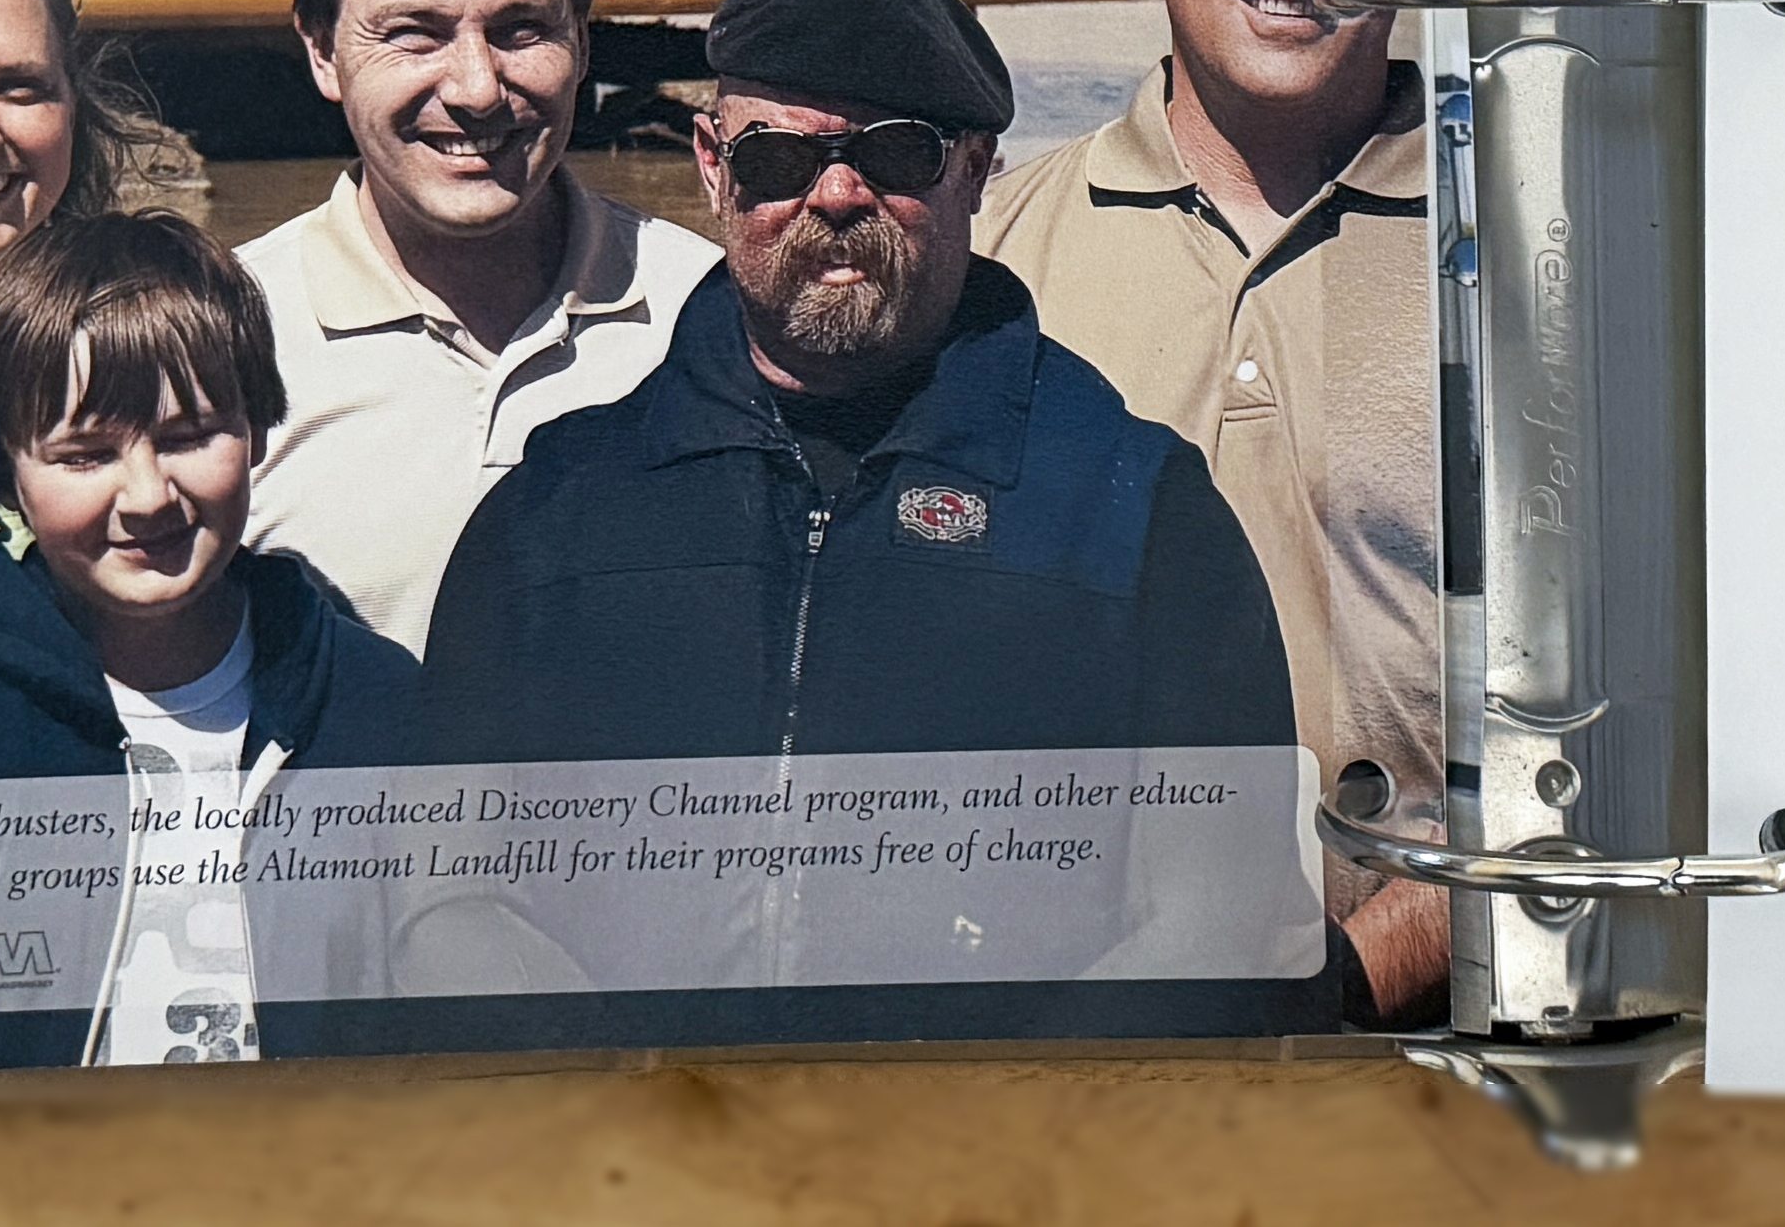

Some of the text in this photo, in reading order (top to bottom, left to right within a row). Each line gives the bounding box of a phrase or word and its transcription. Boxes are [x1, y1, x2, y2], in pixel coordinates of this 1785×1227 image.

[131, 798, 181, 832] the
[194, 793, 301, 837] locally
[313, 789, 465, 837] produced
[478, 789, 637, 827] Discovery
[650, 780, 793, 817] Channel
[805, 787, 949, 823] program,
[963, 774, 1023, 808] and
[1034, 773, 1120, 807] other
[1130, 772, 1238, 805] educa-
[8, 865, 120, 901] groups
[135, 863, 185, 886] use
[198, 850, 247, 884] the
[257, 846, 415, 881] Altamont
[429, 839, 556, 884] Landfill
[565, 838, 616, 883] for
[627, 836, 704, 872] their
[715, 842, 863, 879] programs
[871, 831, 934, 874] free
[945, 829, 980, 871] of
[987, 827, 1101, 871] charge.
